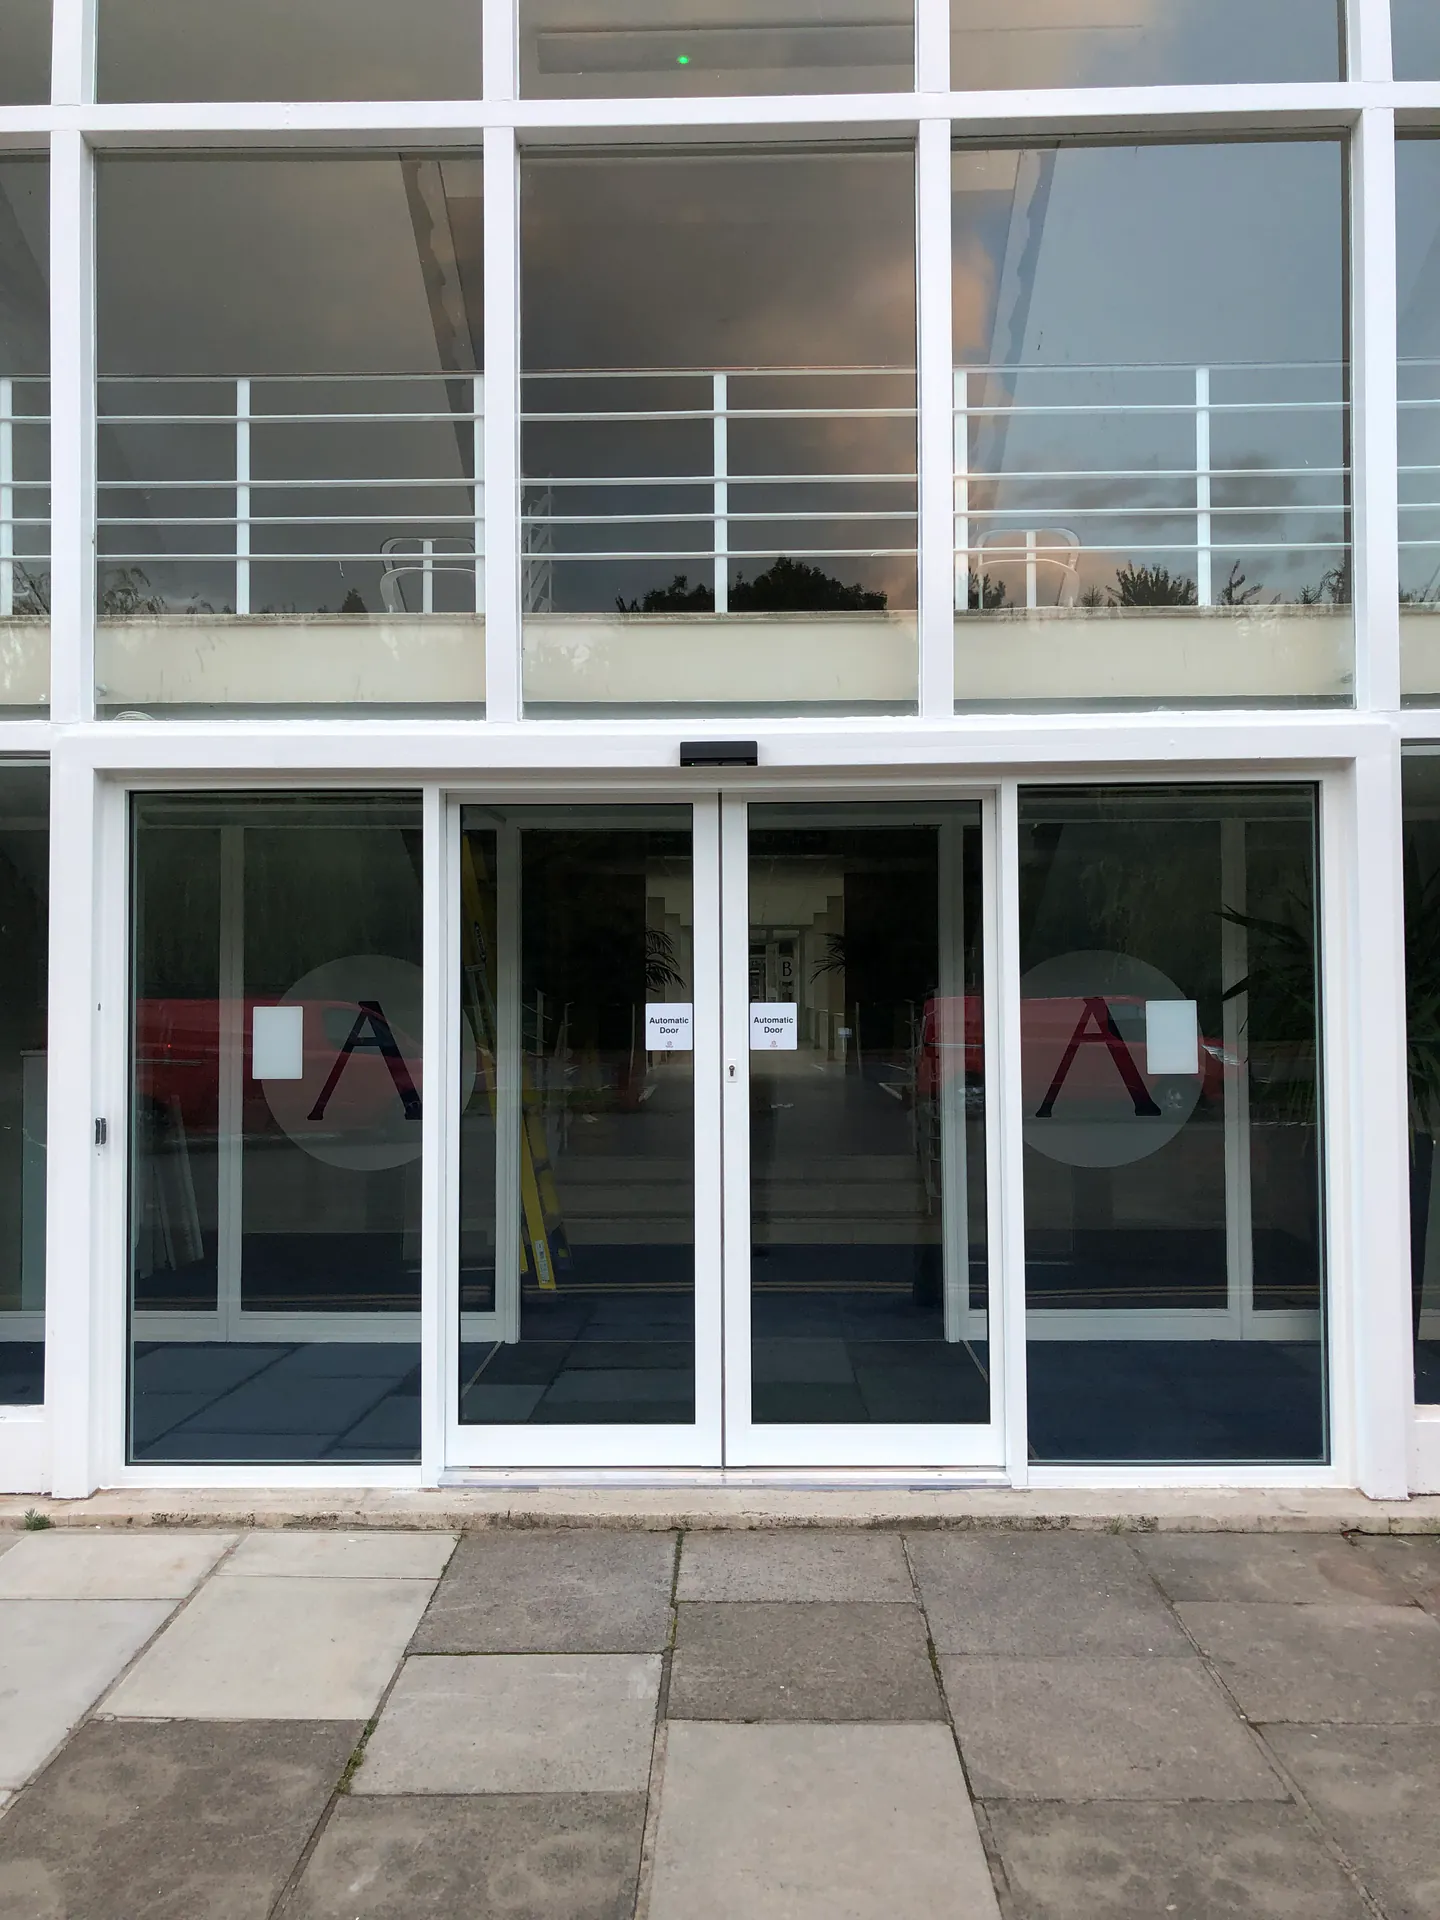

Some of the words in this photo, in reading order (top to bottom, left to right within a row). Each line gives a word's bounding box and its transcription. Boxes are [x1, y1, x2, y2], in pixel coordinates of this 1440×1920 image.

[782, 961, 793, 977] B
[753, 1016, 794, 1024] Automatic
[659, 1026, 679, 1034] Door
[763, 1026, 784, 1034] Door
[307, 1000, 424, 1121] A
[1035, 996, 1162, 1118] A
